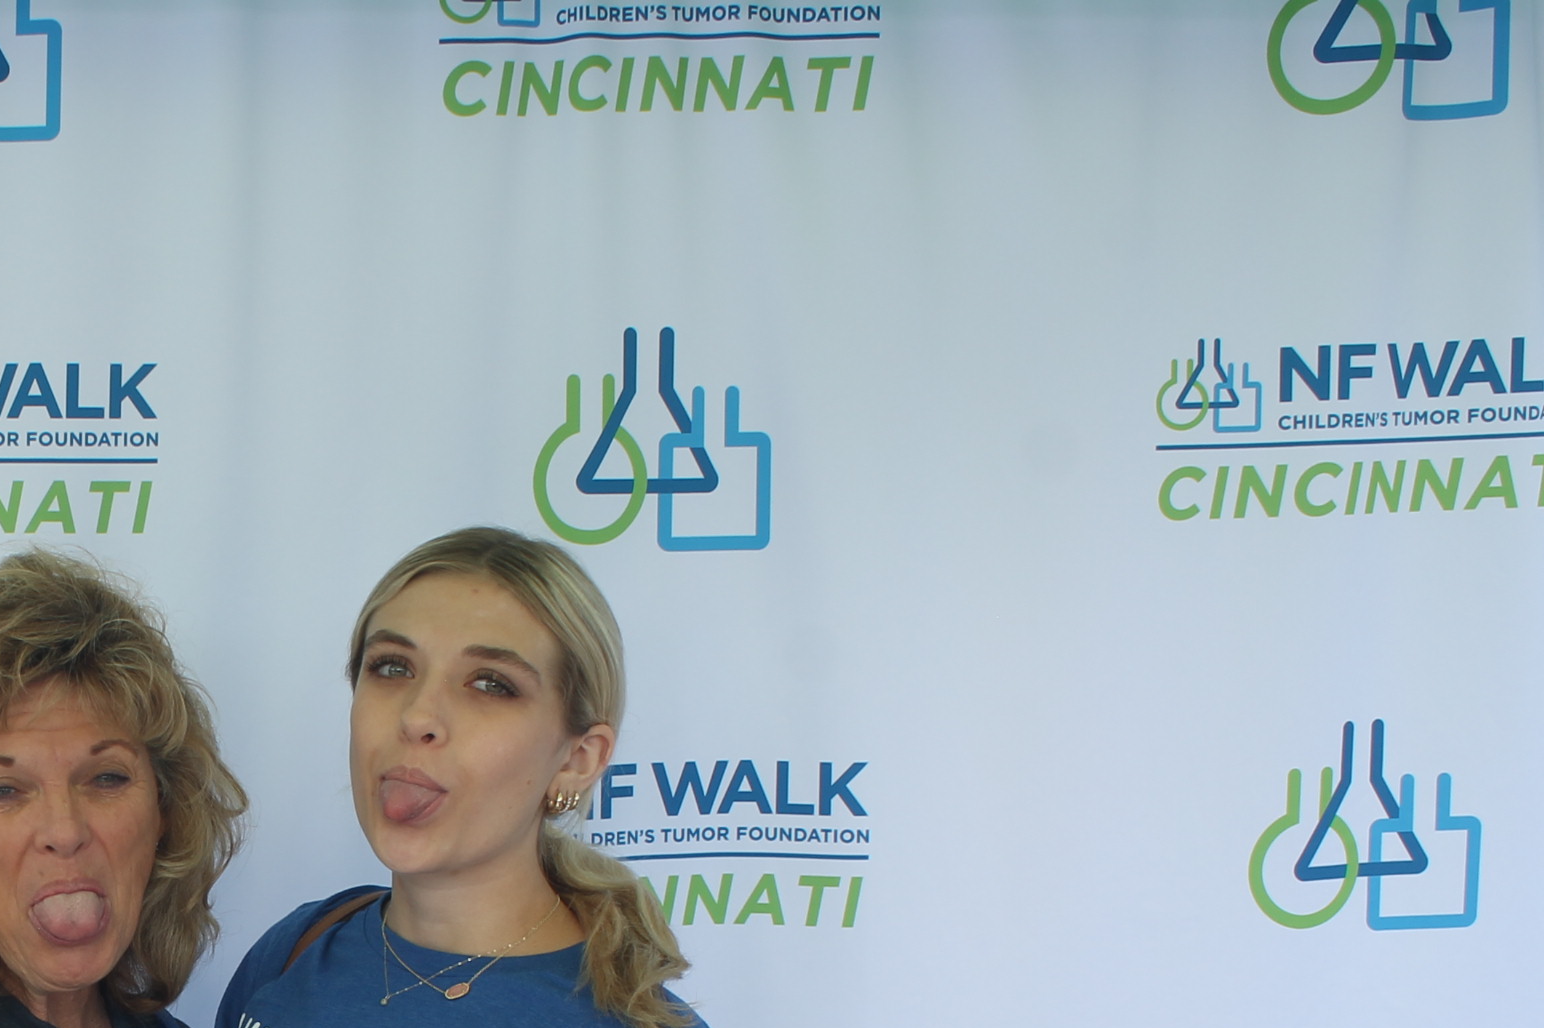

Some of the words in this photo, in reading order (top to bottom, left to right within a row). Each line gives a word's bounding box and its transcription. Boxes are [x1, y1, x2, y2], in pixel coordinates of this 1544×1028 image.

[556, 5, 667, 25] CHILDREN'S
[672, 5, 741, 22] TUMOR
[748, 5, 881, 23] FOUNDATION
[442, 55, 874, 117] CINCINNATI
[1279, 343, 1377, 403] NF
[1387, 337, 1544, 399] WAL
[1278, 411, 1388, 430] CHILDREN'S
[1393, 409, 1460, 427] TUMOR
[26, 431, 159, 448] FOUNDATION
[587, 763, 638, 820] F
[651, 759, 868, 817] WALK
[590, 829, 655, 847] DREN'S
[661, 826, 729, 843] TUMOR
[736, 827, 870, 844] FOUNDATION
[638, 873, 863, 928] NNATI
